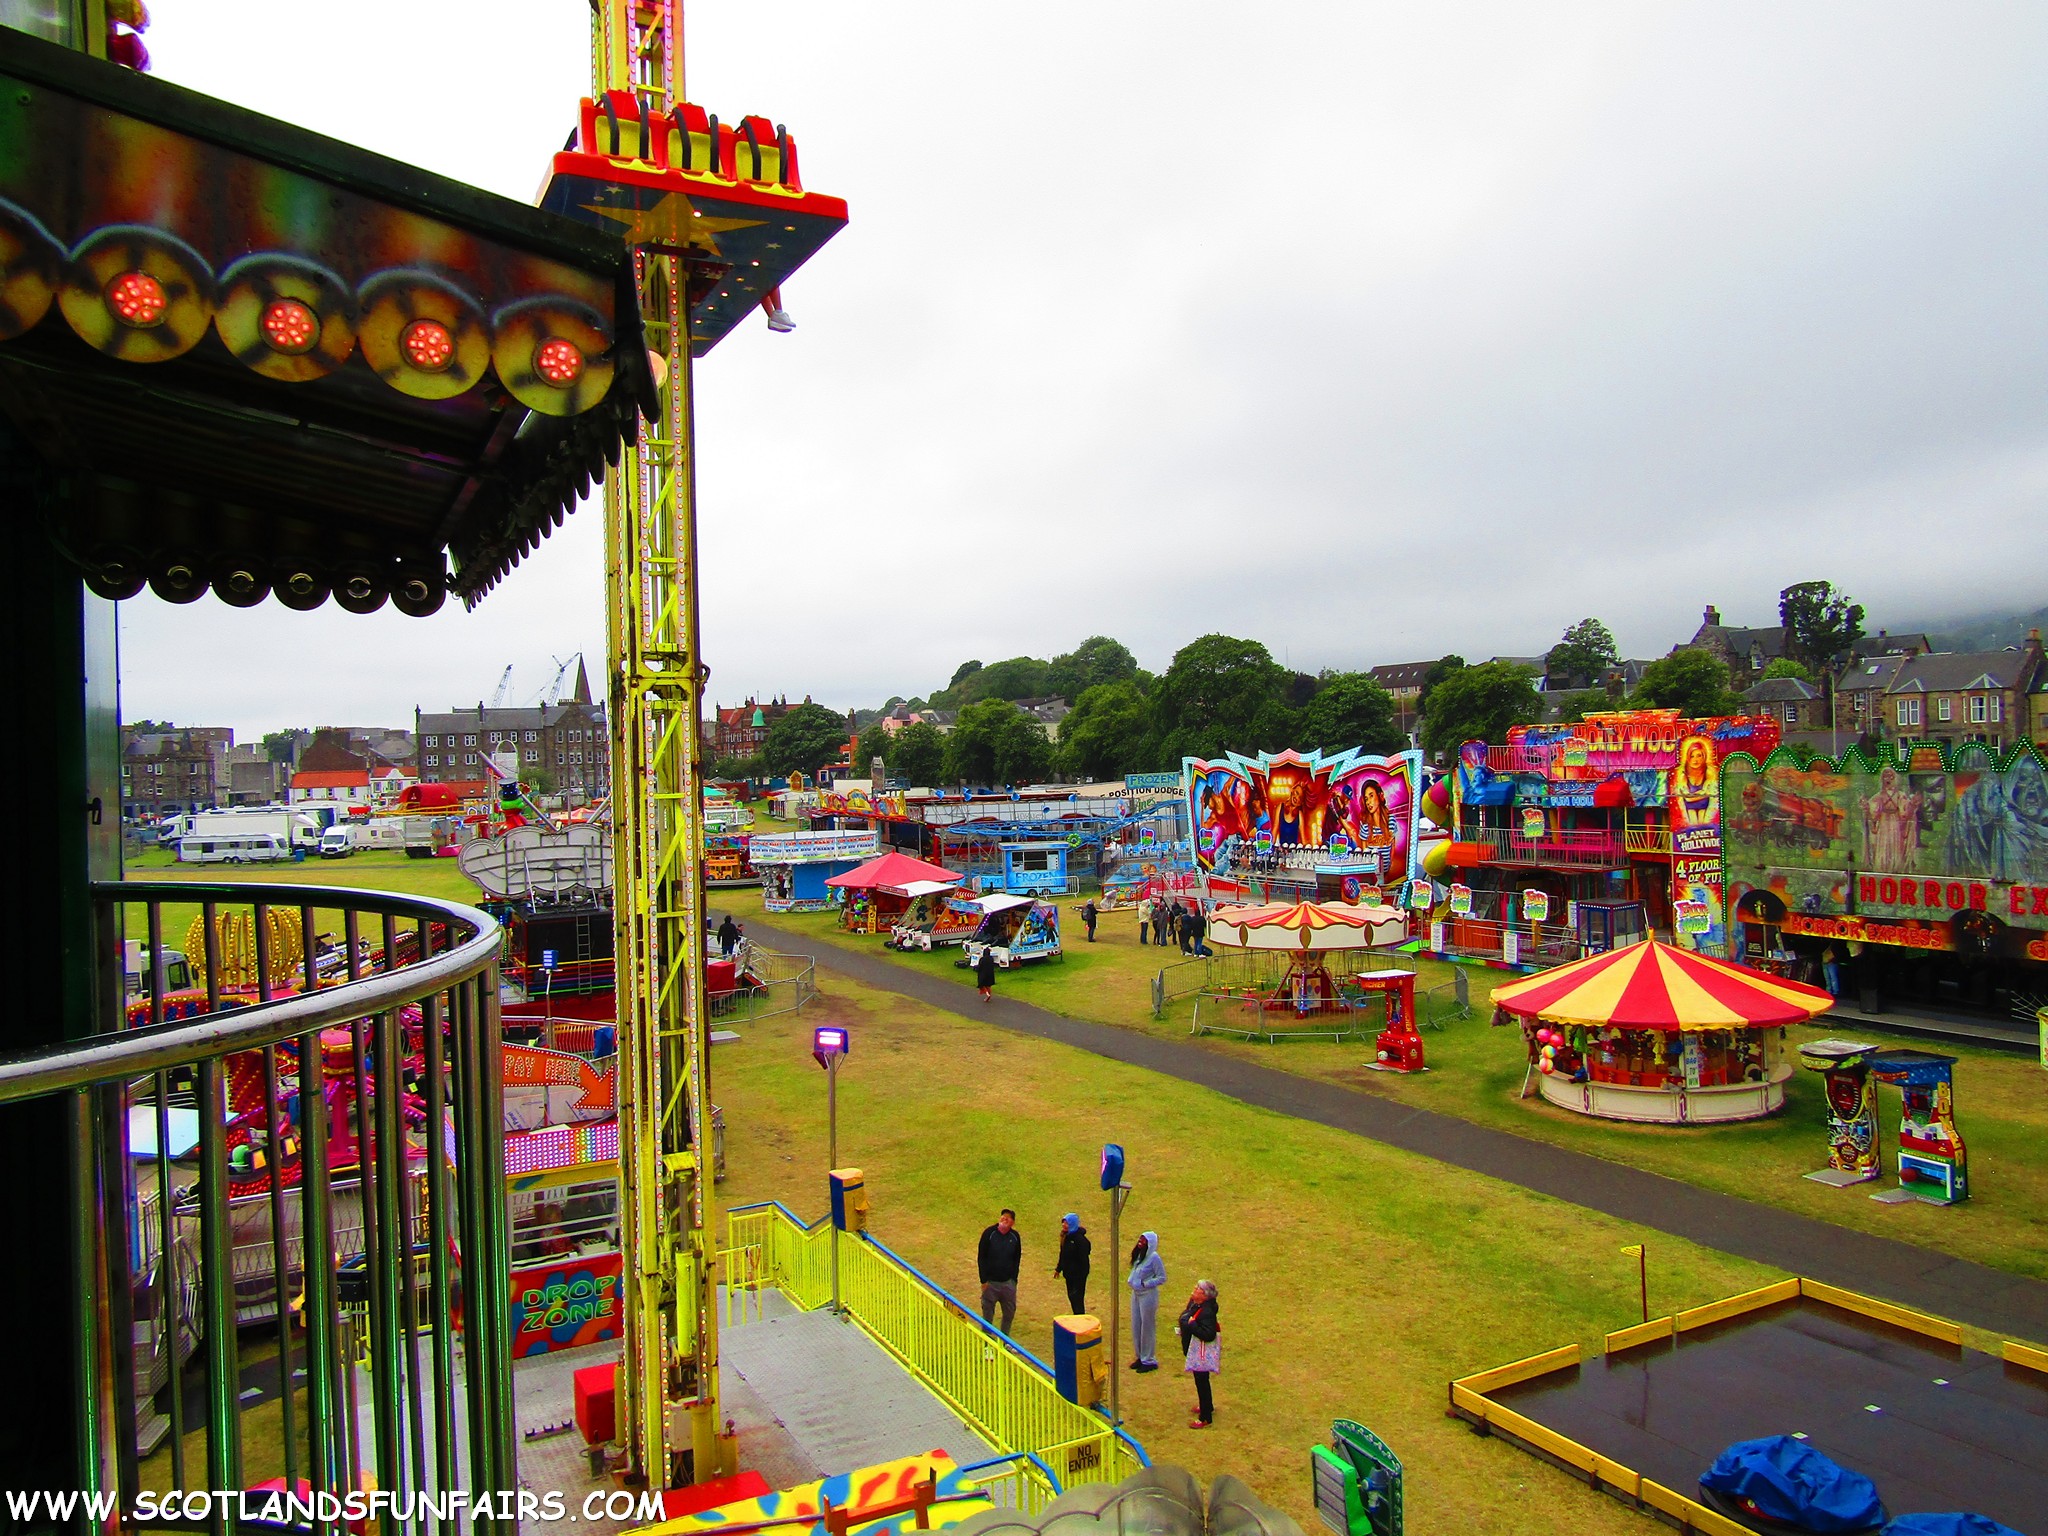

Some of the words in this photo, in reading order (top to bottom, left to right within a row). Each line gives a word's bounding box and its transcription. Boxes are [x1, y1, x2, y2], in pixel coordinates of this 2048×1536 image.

[1130, 773, 1176, 786] FROZEN
[1550, 796, 1569, 807] FUN
[1677, 829, 1715, 842] PLANET
[1015, 871, 1056, 884] FROZEN
[1675, 859, 1687, 878] 4
[1688, 859, 1722, 873] FLOOR
[1688, 873, 1701, 883] OF
[1859, 875, 1987, 912] HORROR
[1789, 915, 1866, 942] HORROR
[1867, 922, 1943, 948] EXPRESS
[504, 1054, 536, 1078] PAY
[545, 1058, 582, 1084] HERE
[1937, 1081, 1965, 1167] BOXER
[522, 1275, 616, 1310] DROP
[522, 1297, 616, 1333] ZONE
[1077, 1444, 1091, 1458] NO
[1068, 1453, 1100, 1474] ENTRY
